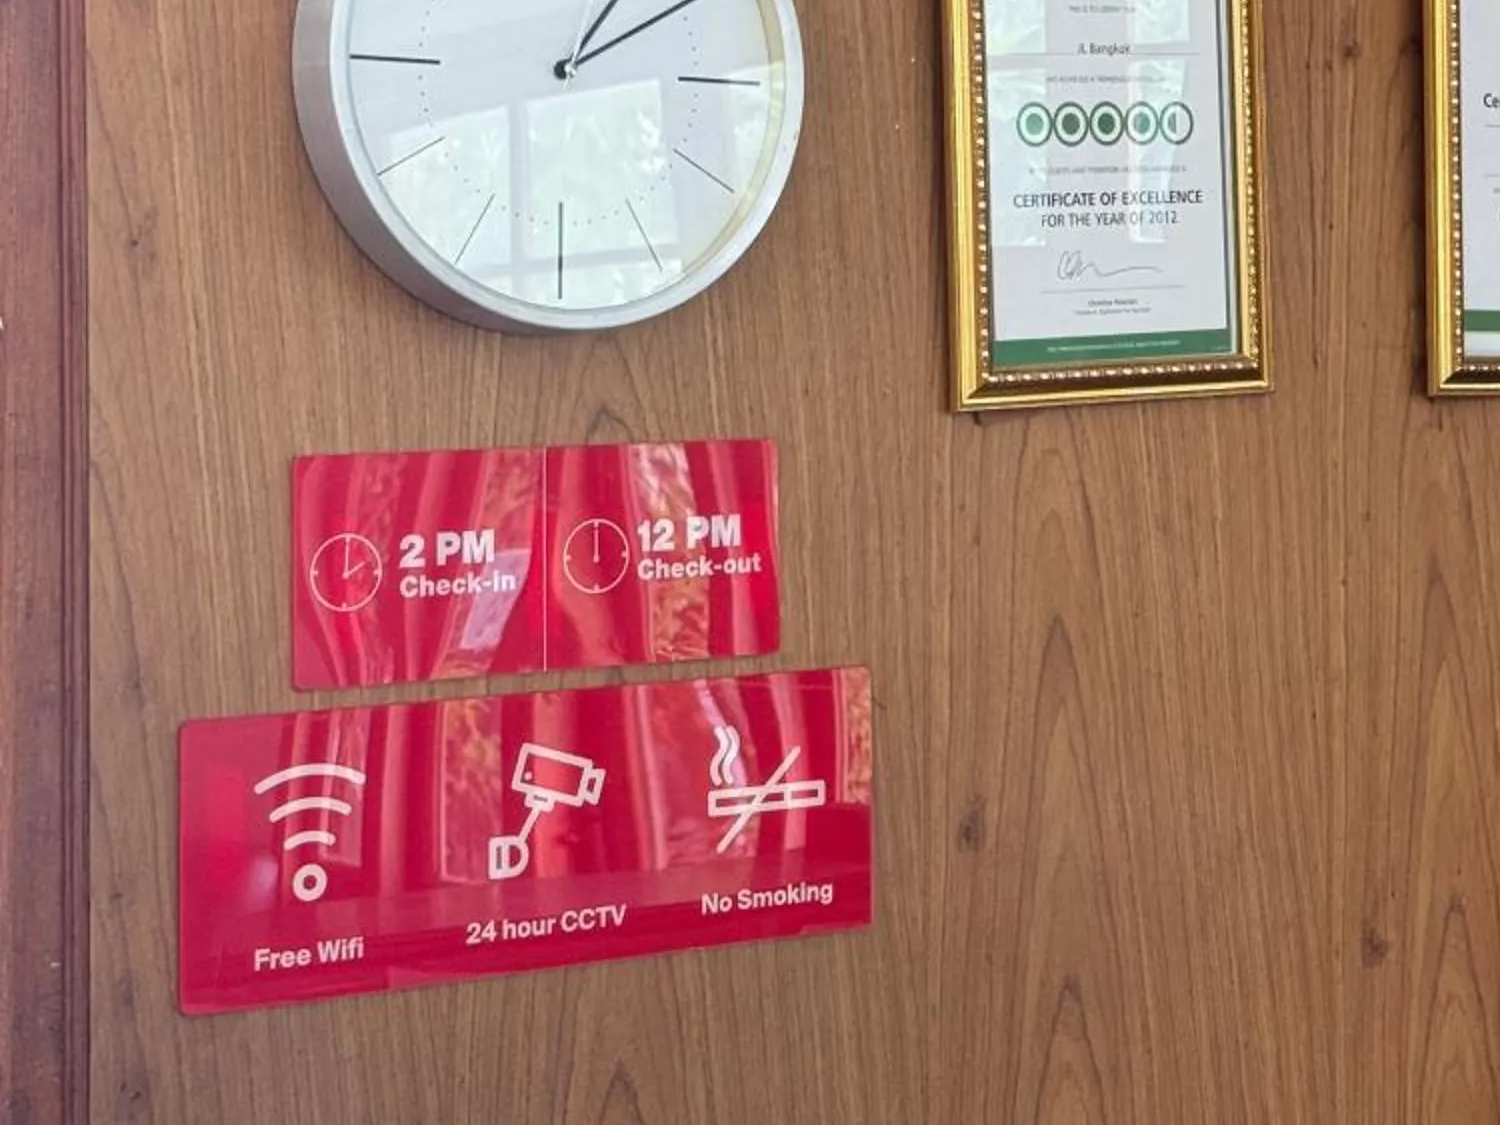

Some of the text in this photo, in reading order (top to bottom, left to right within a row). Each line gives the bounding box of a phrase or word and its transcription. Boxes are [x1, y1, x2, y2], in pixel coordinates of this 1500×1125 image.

[1089, 43, 1131, 56] Bangkok
[1013, 189, 1204, 208] CERTIFICATE OF EXCELLENCE
[1041, 210, 1179, 227] FOR THE YEAR OF 2012
[399, 529, 496, 569] 2 PM
[637, 514, 742, 553] 12 PM
[636, 553, 763, 581] Check-out
[700, 881, 834, 916] No Smoking
[465, 904, 628, 946] 24 hour CCTV
[253, 937, 365, 972] Free Wifi
